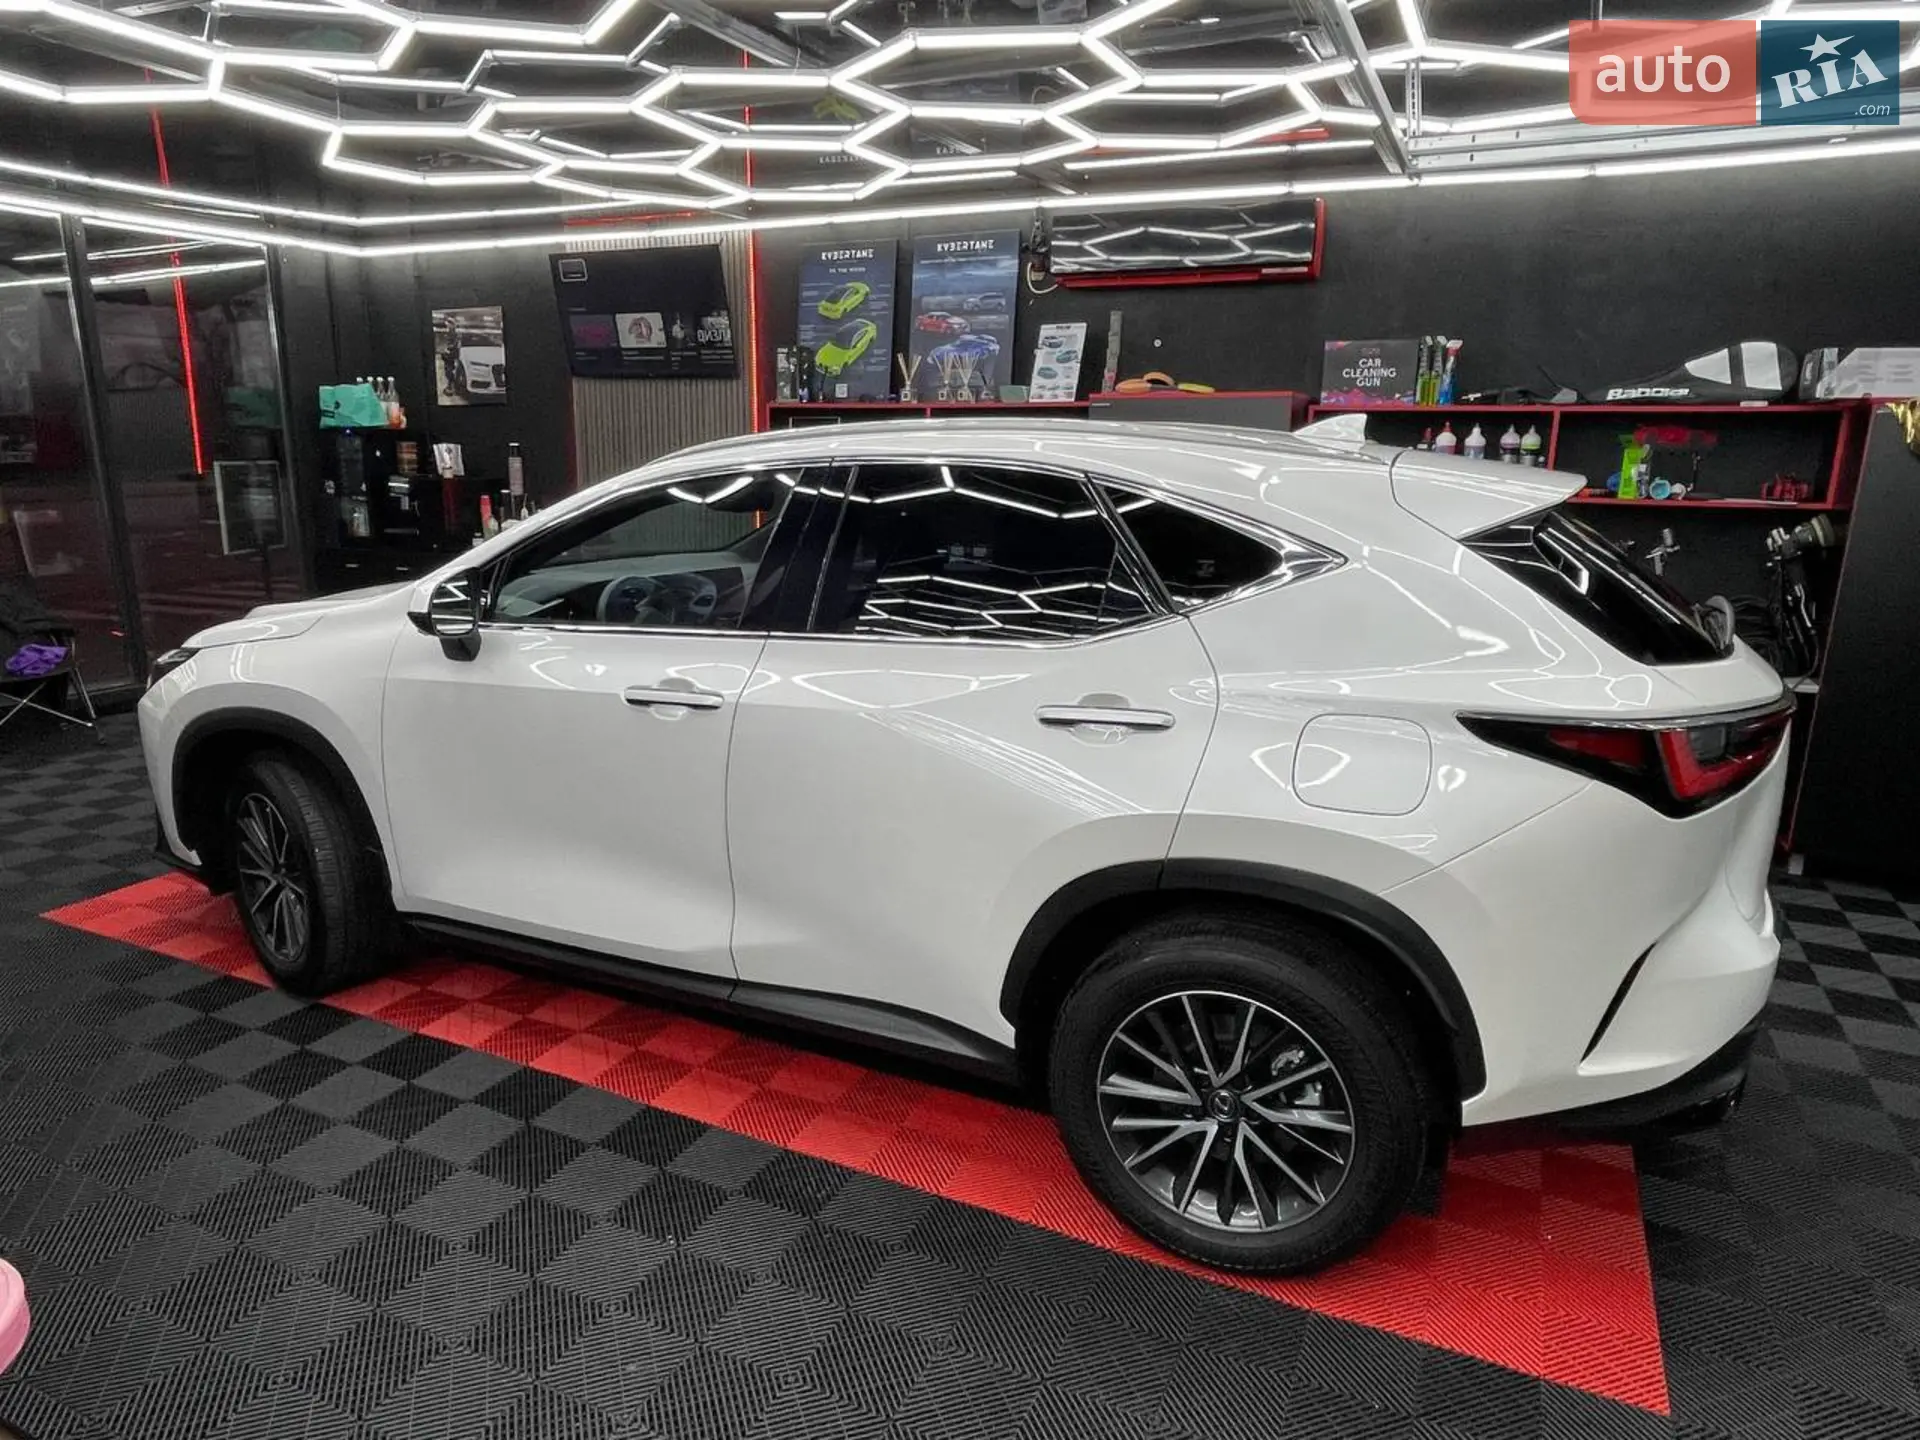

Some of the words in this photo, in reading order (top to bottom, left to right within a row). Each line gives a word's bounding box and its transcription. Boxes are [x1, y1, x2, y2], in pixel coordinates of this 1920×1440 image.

[1358, 358, 1382, 369] CAR
[1342, 368, 1397, 379] CLEANING
[1356, 377, 1381, 388] GUN
